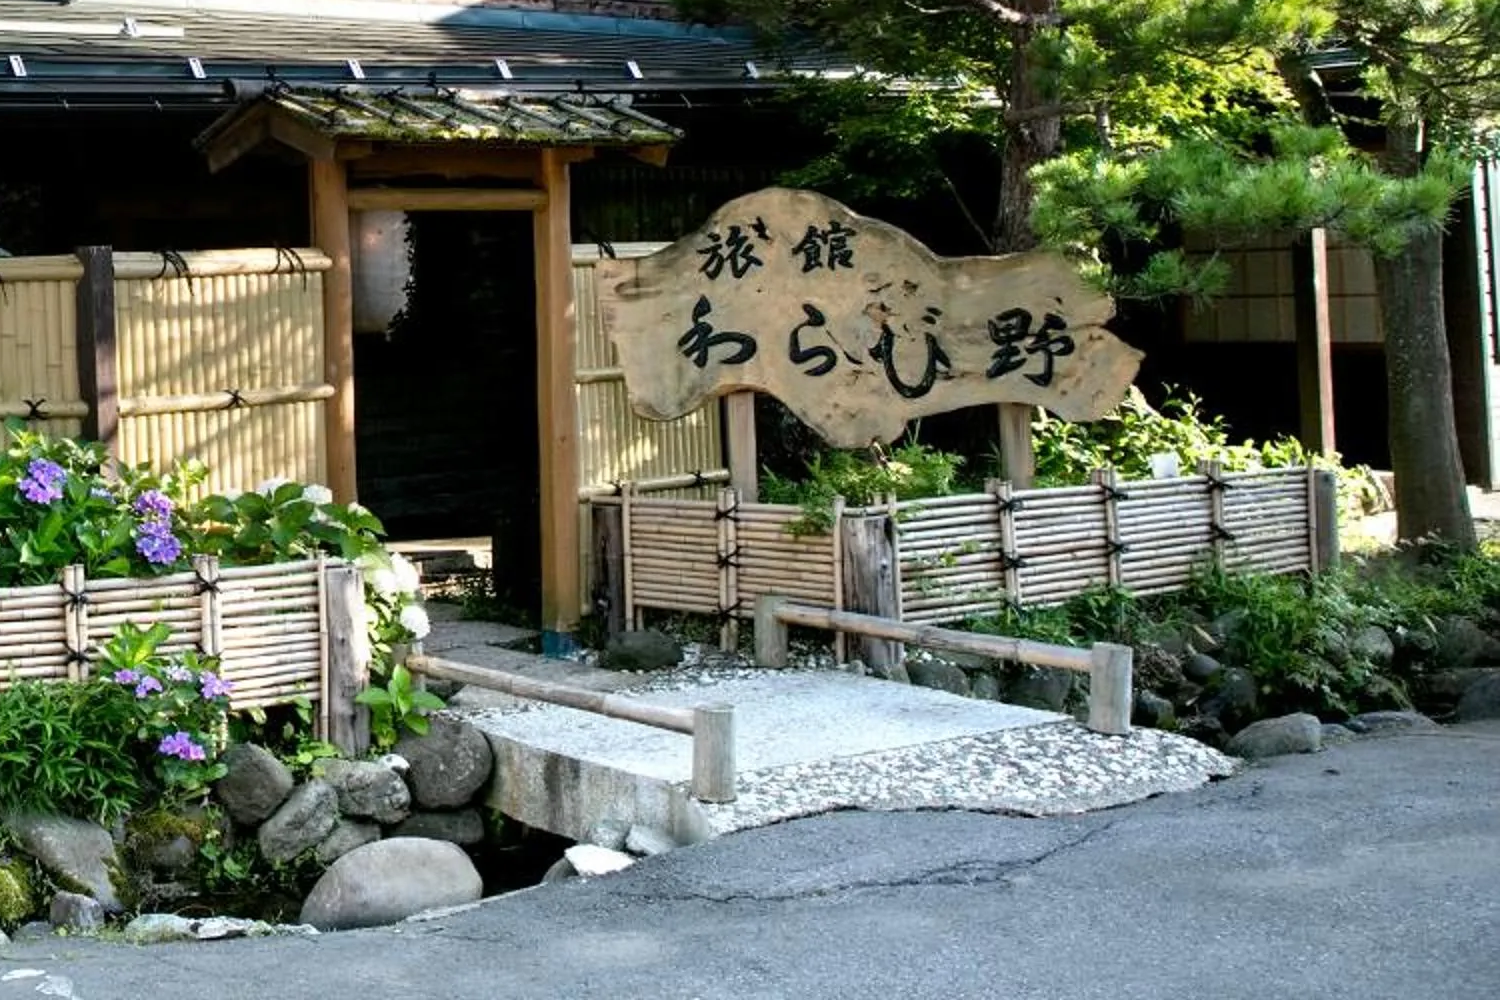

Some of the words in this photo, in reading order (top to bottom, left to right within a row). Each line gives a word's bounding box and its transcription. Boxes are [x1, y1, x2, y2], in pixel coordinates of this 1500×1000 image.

[697, 220, 857, 280] 旅館
[678, 295, 1075, 398] わらび野
